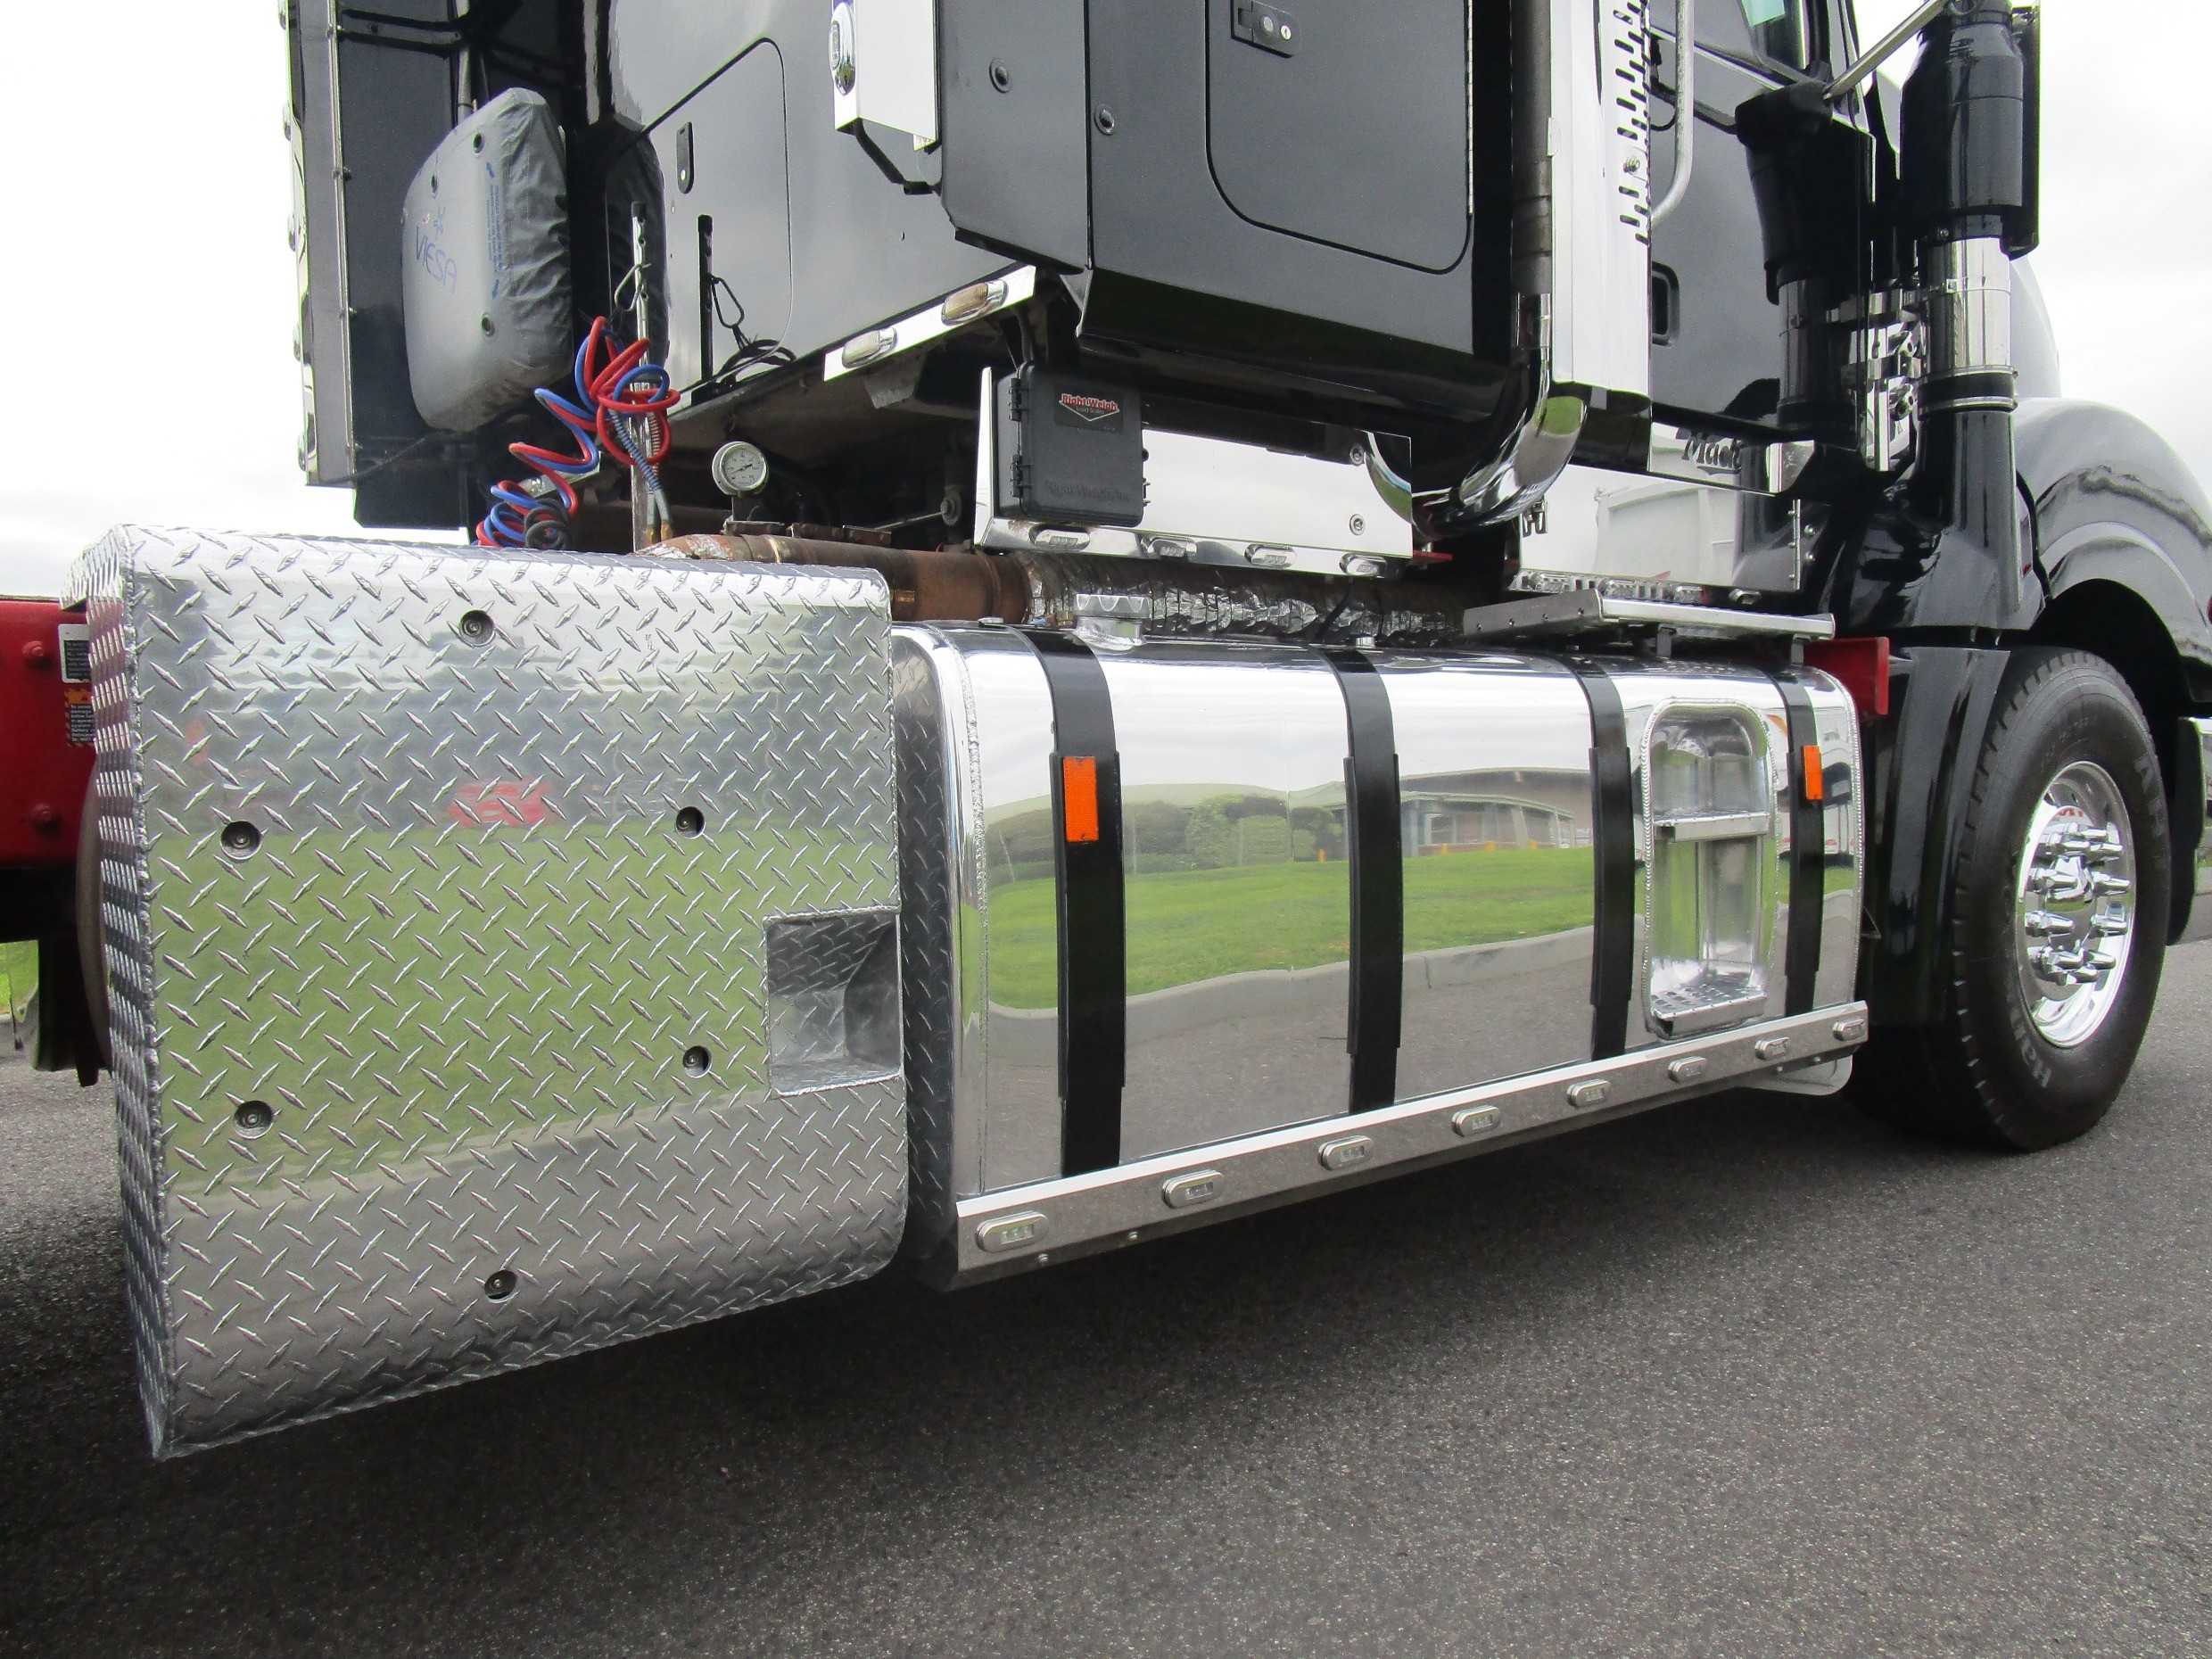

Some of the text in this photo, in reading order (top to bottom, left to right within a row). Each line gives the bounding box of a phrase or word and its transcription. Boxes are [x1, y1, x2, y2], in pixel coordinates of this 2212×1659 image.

[416, 226, 458, 294] VIESA
[1061, 392, 1118, 411] Right Weigh
